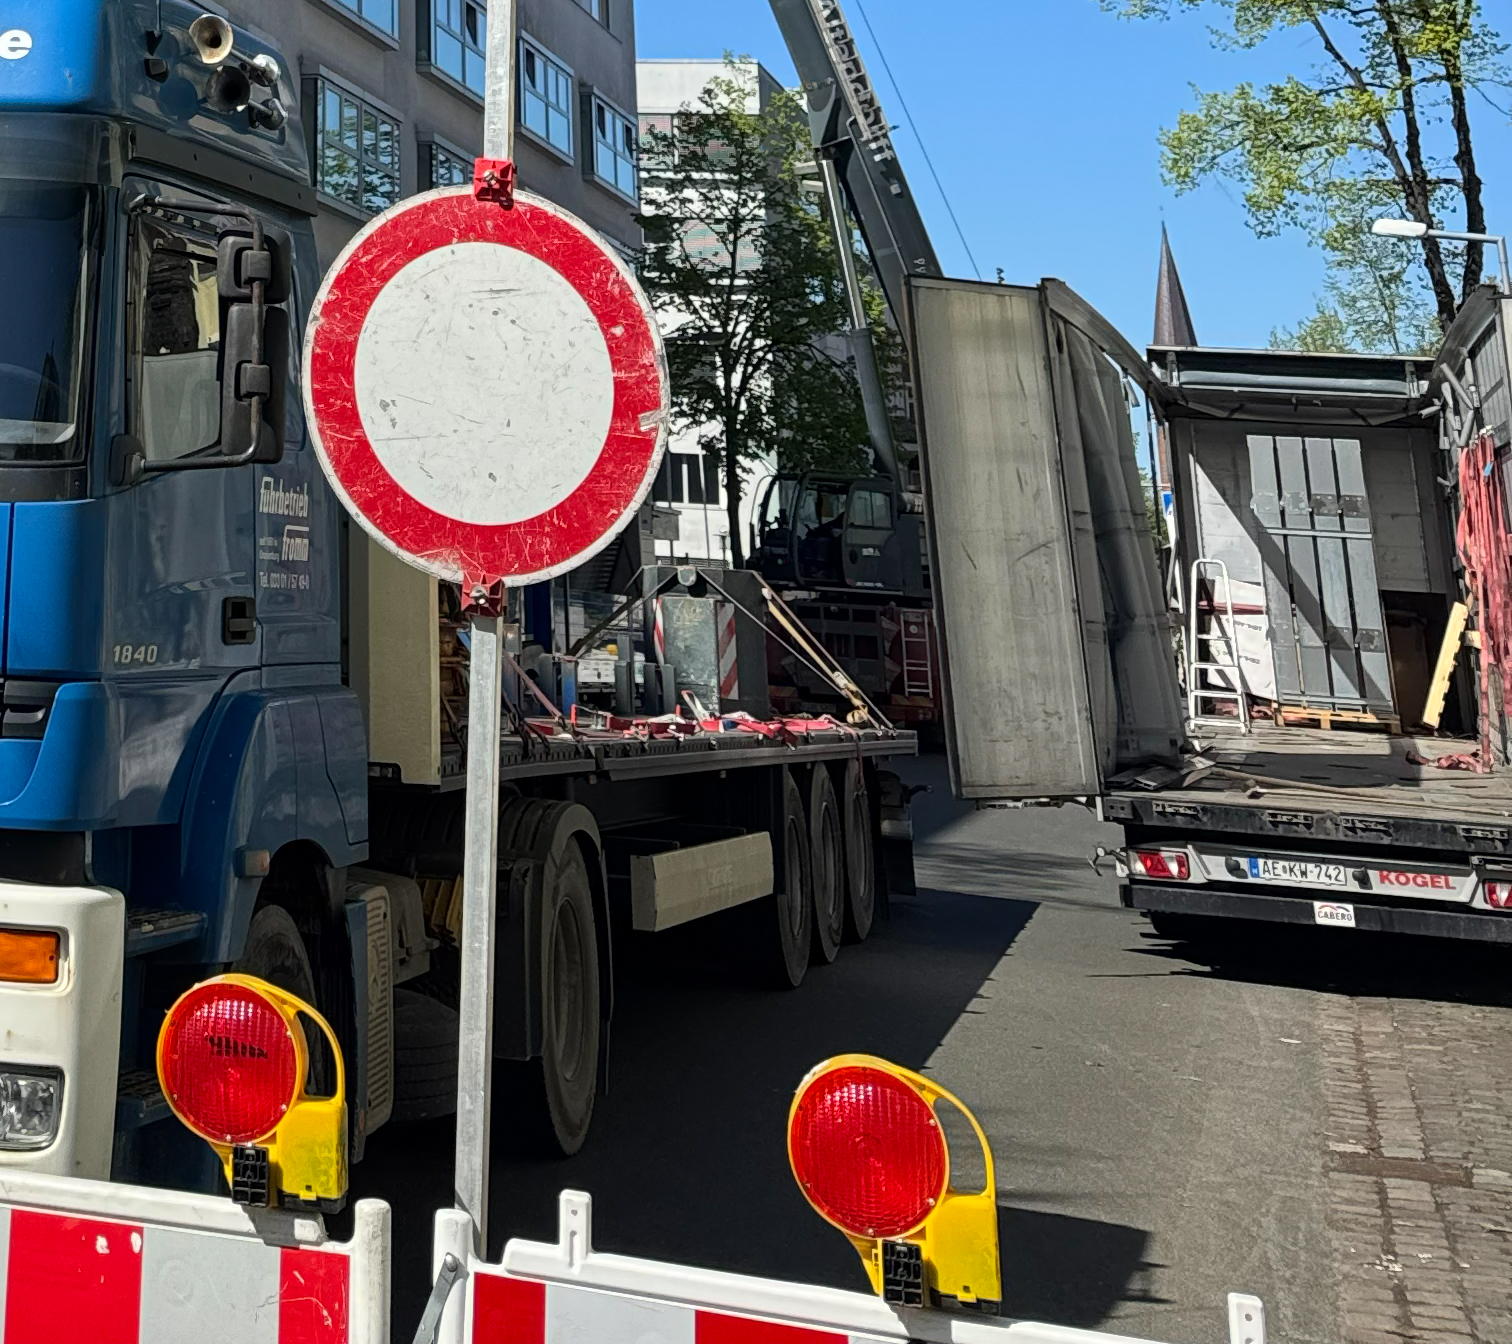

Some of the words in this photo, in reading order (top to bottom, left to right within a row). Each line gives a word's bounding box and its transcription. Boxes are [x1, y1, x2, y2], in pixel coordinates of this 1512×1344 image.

[280, 524, 310, 562] fromm
[113, 645, 158, 664] 1840
[1262, 860, 1282, 877] AE
